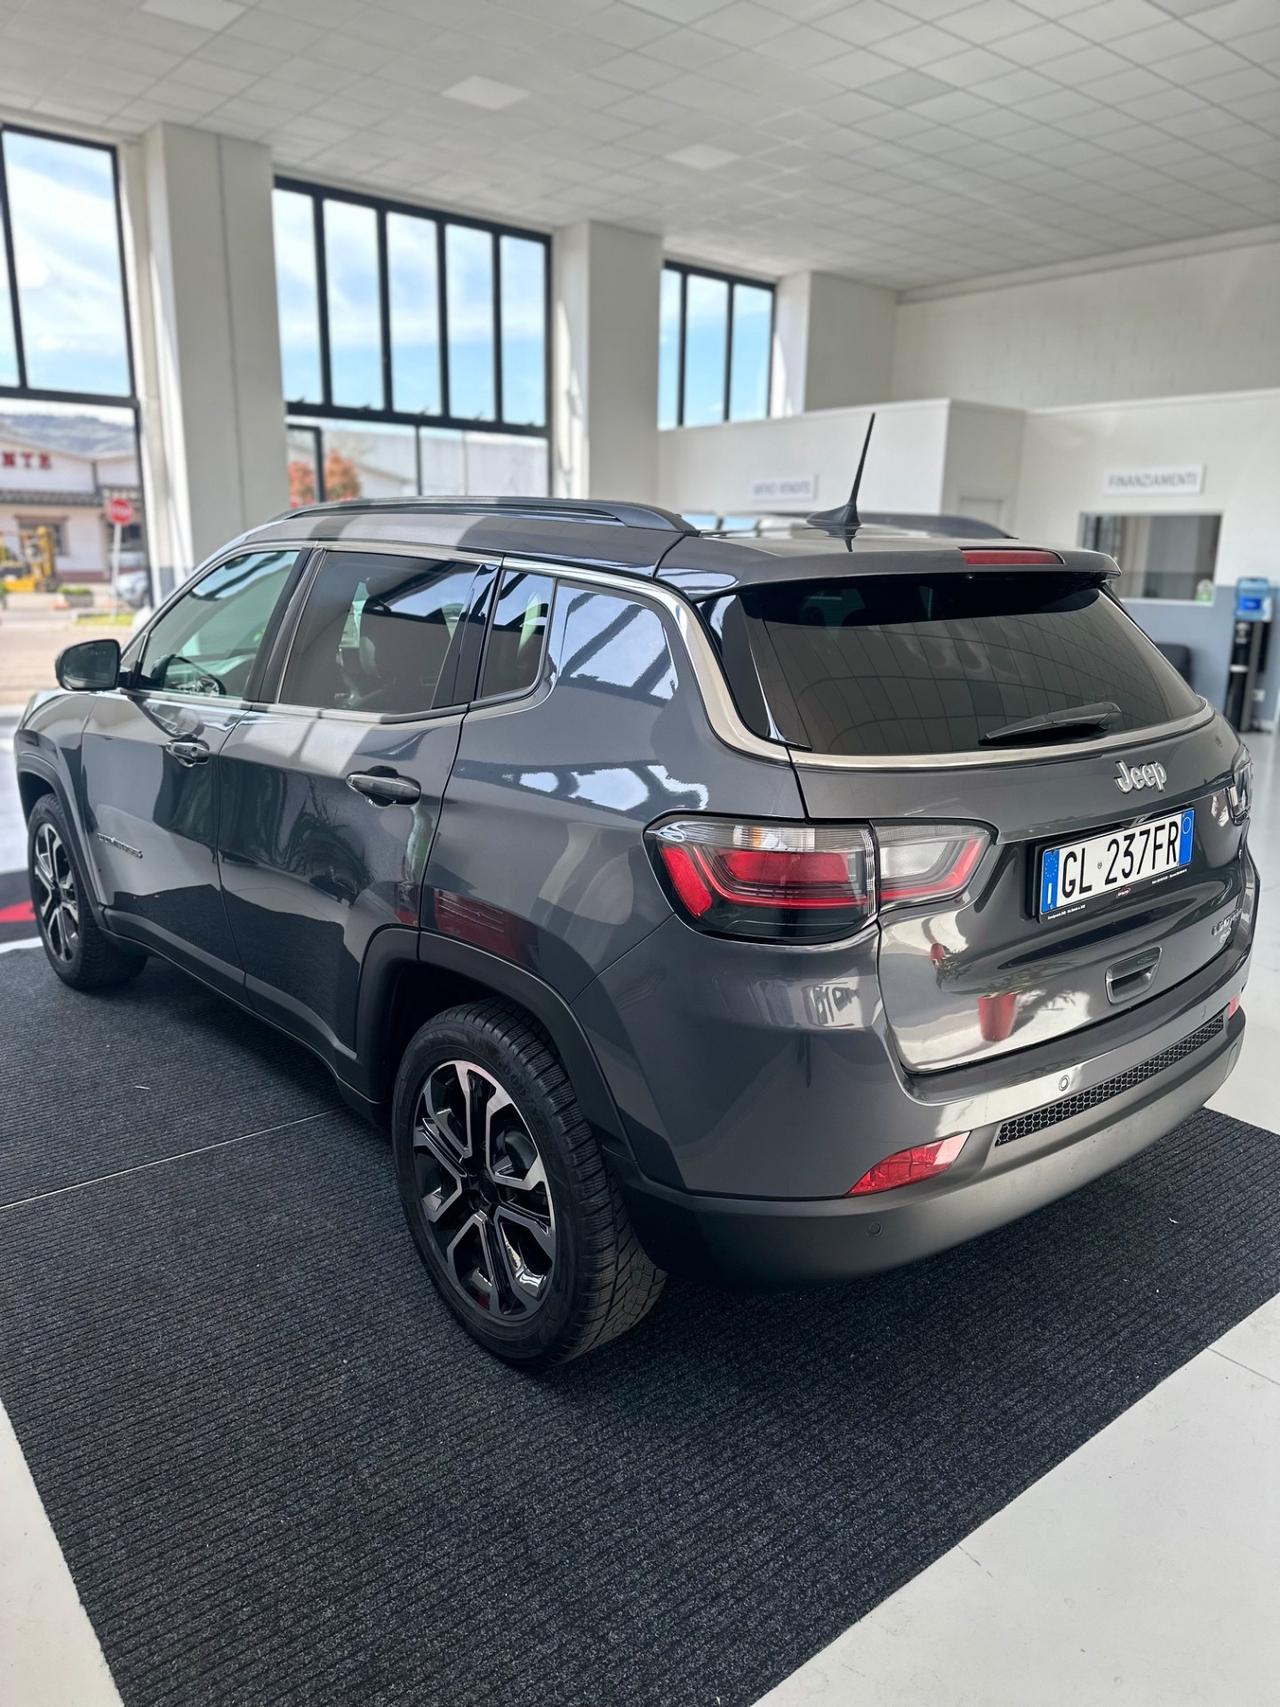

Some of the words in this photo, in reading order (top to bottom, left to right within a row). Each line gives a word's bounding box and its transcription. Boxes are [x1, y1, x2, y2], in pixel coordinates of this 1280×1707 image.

[1107, 471, 1199, 489] FINANZIAMENTI
[1113, 759, 1167, 793] Jeep
[1061, 848, 1093, 899] GL
[1104, 820, 1179, 886] 237FR
